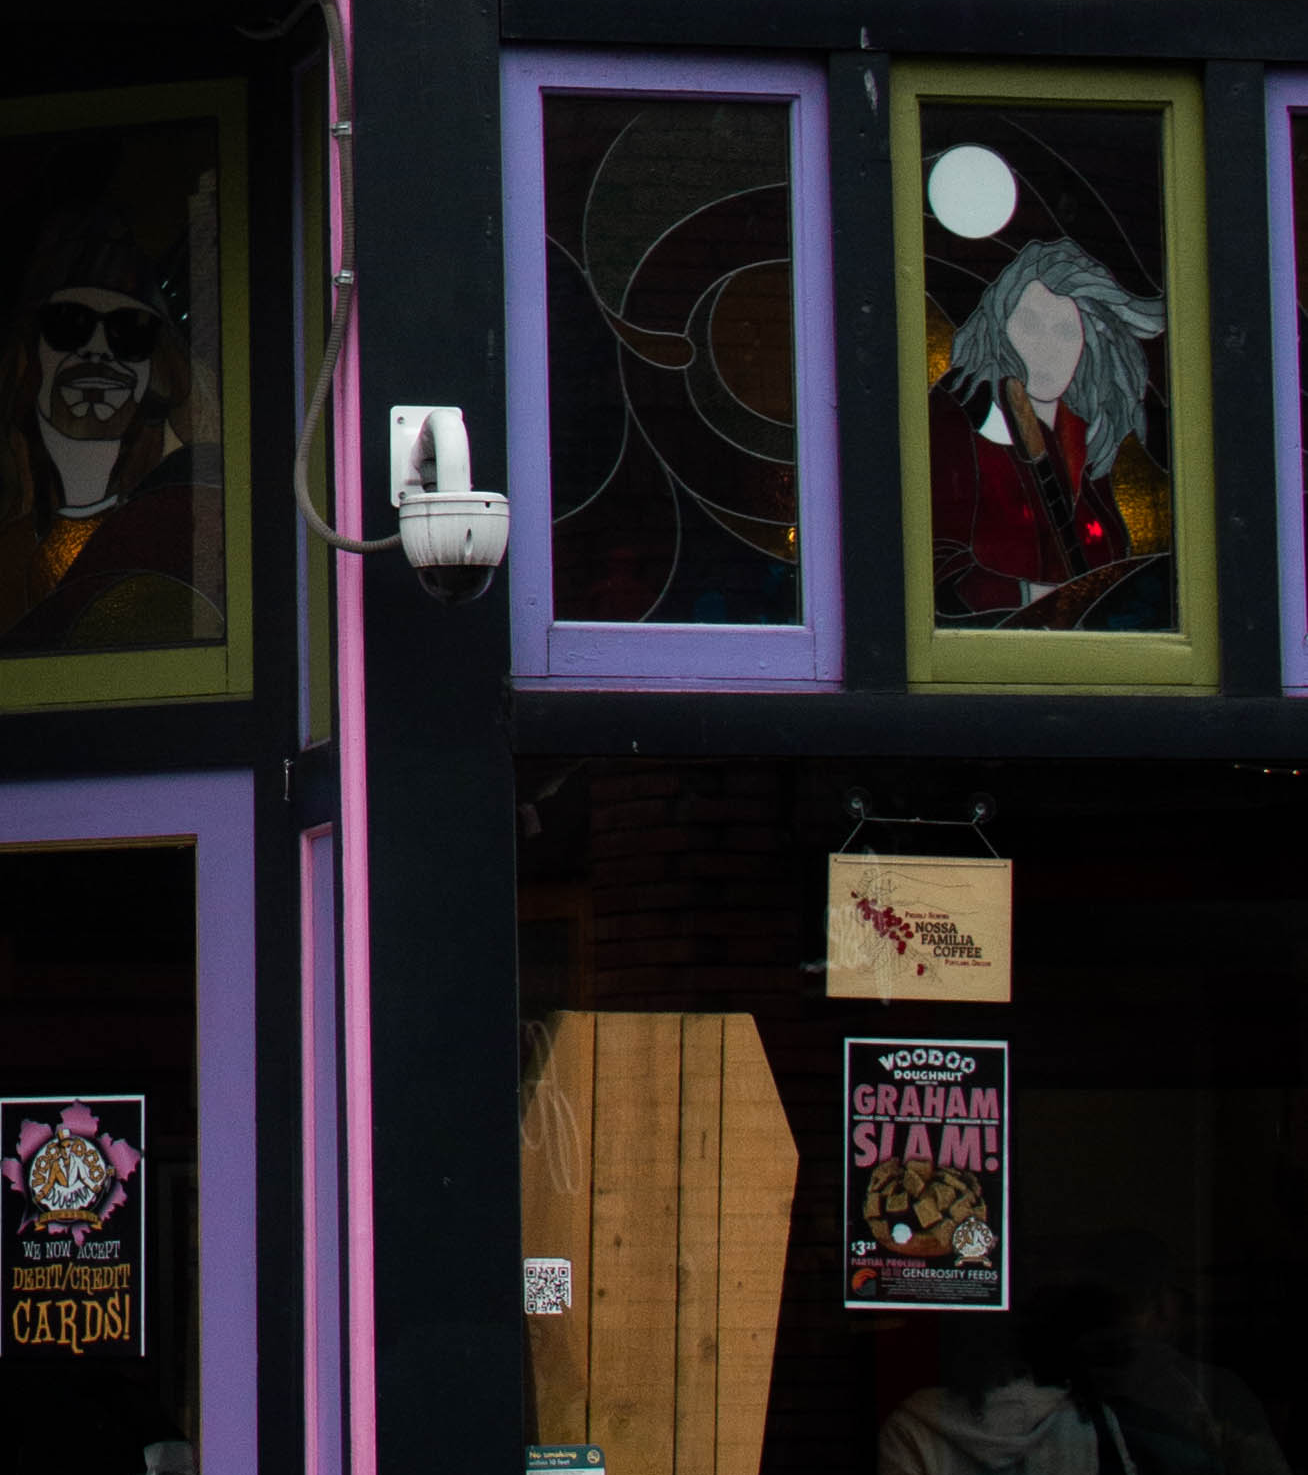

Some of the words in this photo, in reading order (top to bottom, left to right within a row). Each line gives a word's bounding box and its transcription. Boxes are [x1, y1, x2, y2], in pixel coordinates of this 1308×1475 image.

[915, 920, 959, 934] NOSSA
[921, 933, 975, 946] FAMILIA
[933, 945, 984, 959] COFFEE
[876, 1048, 977, 1075] VOODOO
[893, 1069, 964, 1081] DOUGHNUT
[853, 1082, 1001, 1120] GRAHAM
[22, 1239, 42, 1260] WE
[45, 1239, 72, 1259] NOW
[76, 1239, 121, 1260] ACCEPT
[11, 1262, 132, 1296] DEBIT/CREDIT
[902, 1267, 966, 1279] GENEROSITY
[967, 1269, 1000, 1281] FEEDS
[11, 1290, 132, 1354] CARDS!
